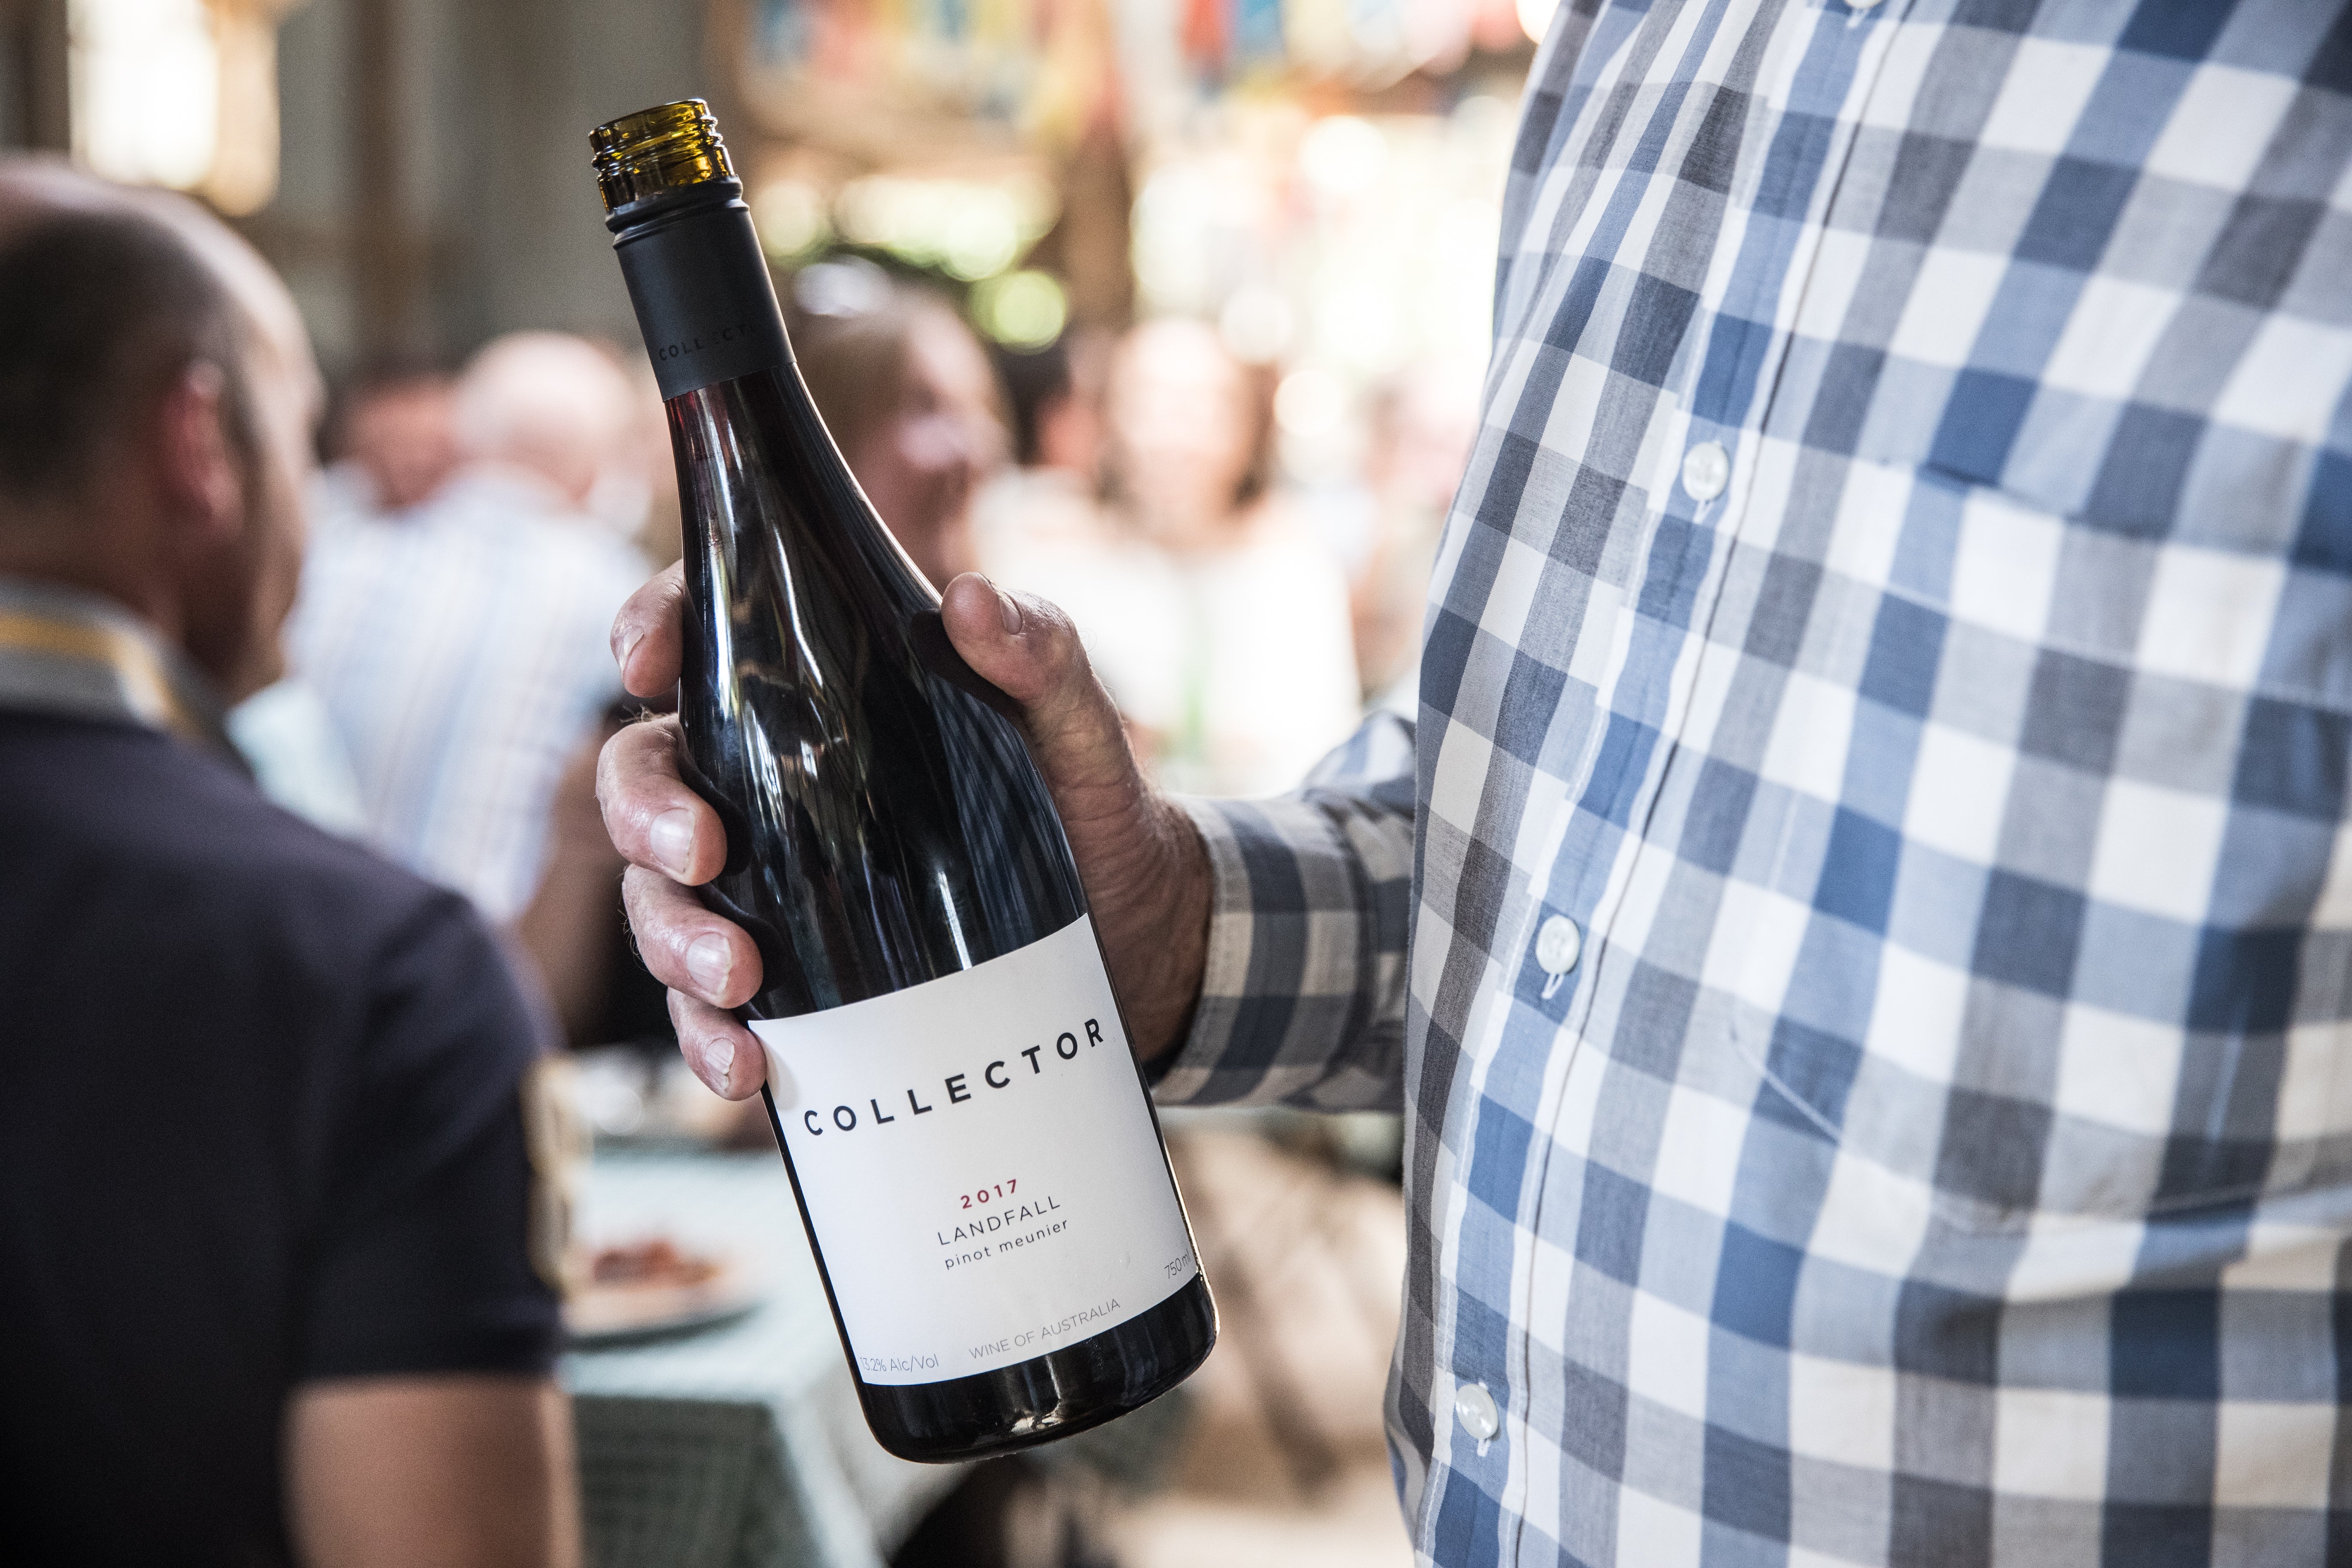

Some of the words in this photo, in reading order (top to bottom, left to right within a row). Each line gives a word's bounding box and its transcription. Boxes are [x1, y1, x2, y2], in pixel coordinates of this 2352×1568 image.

[804, 1018, 1103, 1136] COLLECTOR
[960, 1179, 1017, 1210] 2017
[937, 1196, 1060, 1245] LANDFALL
[945, 1247, 991, 1270] pinot
[999, 1220, 1067, 1253] meunier
[969, 1339, 1011, 1359] WINE
[1014, 1331, 1035, 1347] OF
[1042, 1298, 1121, 1339] AUSTRALIA
[860, 1357, 887, 1372] 13.2%
[891, 1354, 939, 1372] Alc/Vol
